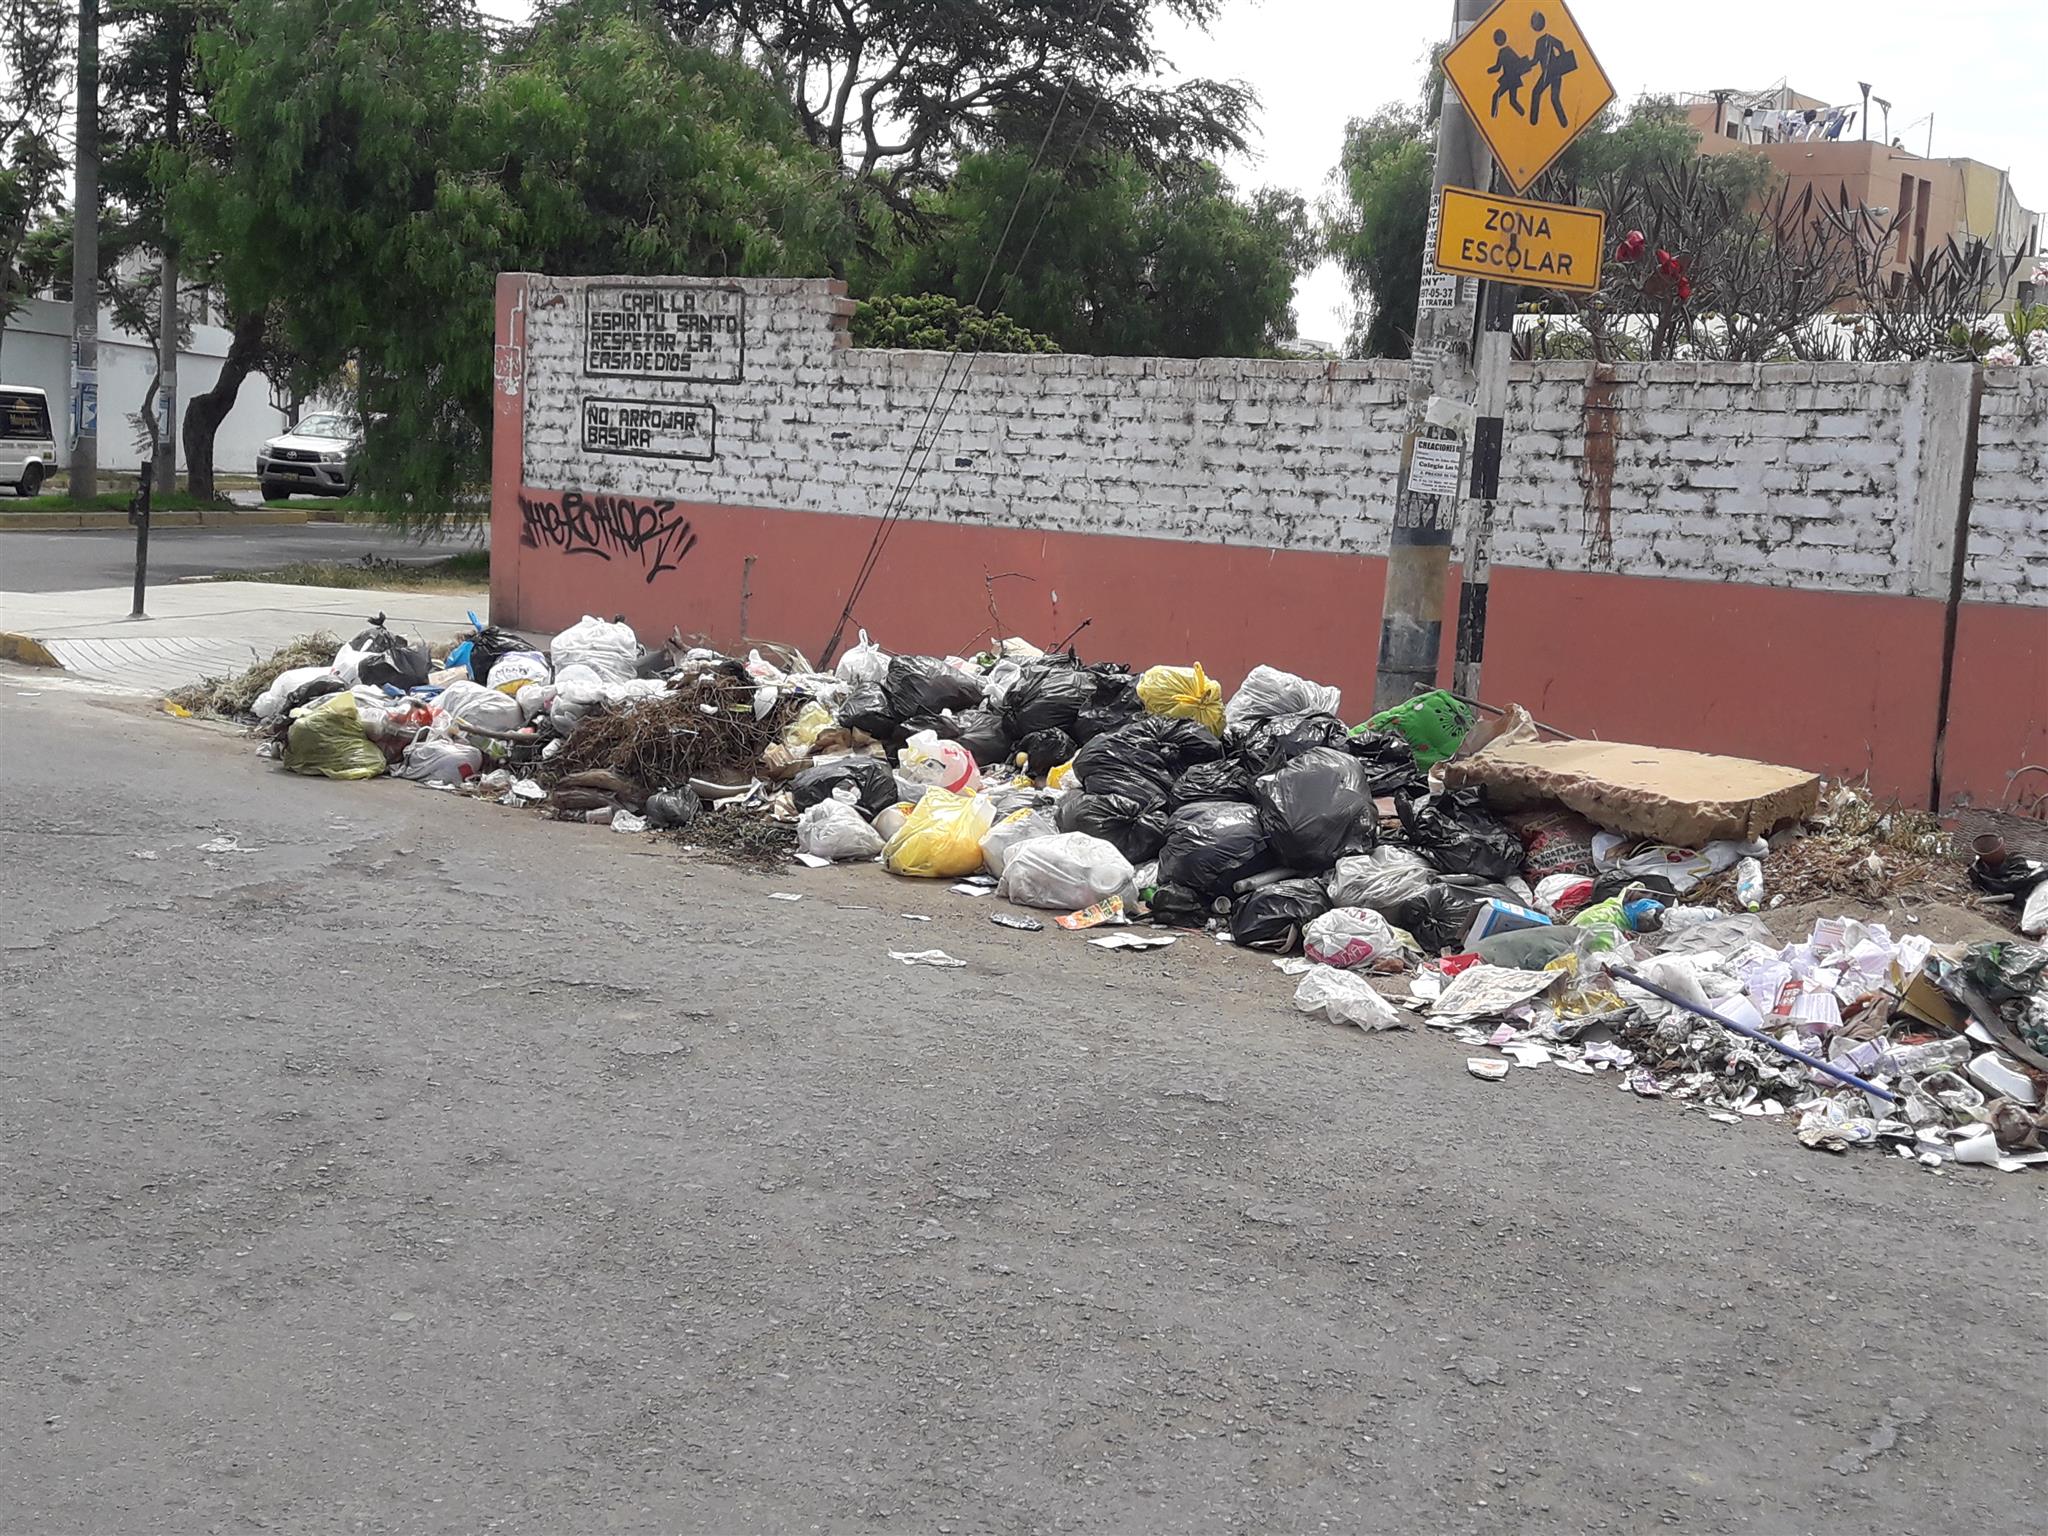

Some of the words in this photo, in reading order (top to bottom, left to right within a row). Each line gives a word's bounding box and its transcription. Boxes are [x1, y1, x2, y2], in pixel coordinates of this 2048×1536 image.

[1484, 207, 1551, 239] ZONA
[1461, 239, 1573, 275] ESCOLAR
[622, 292, 695, 314] CAPILLA
[590, 313, 666, 332] ESPIRITU
[676, 314, 738, 333] SANTO
[590, 331, 676, 352] RESPETAR
[687, 333, 712, 353] LA
[587, 406, 609, 426] NO
[618, 409, 697, 431] ARROJAR
[587, 426, 651, 448] BASURA
